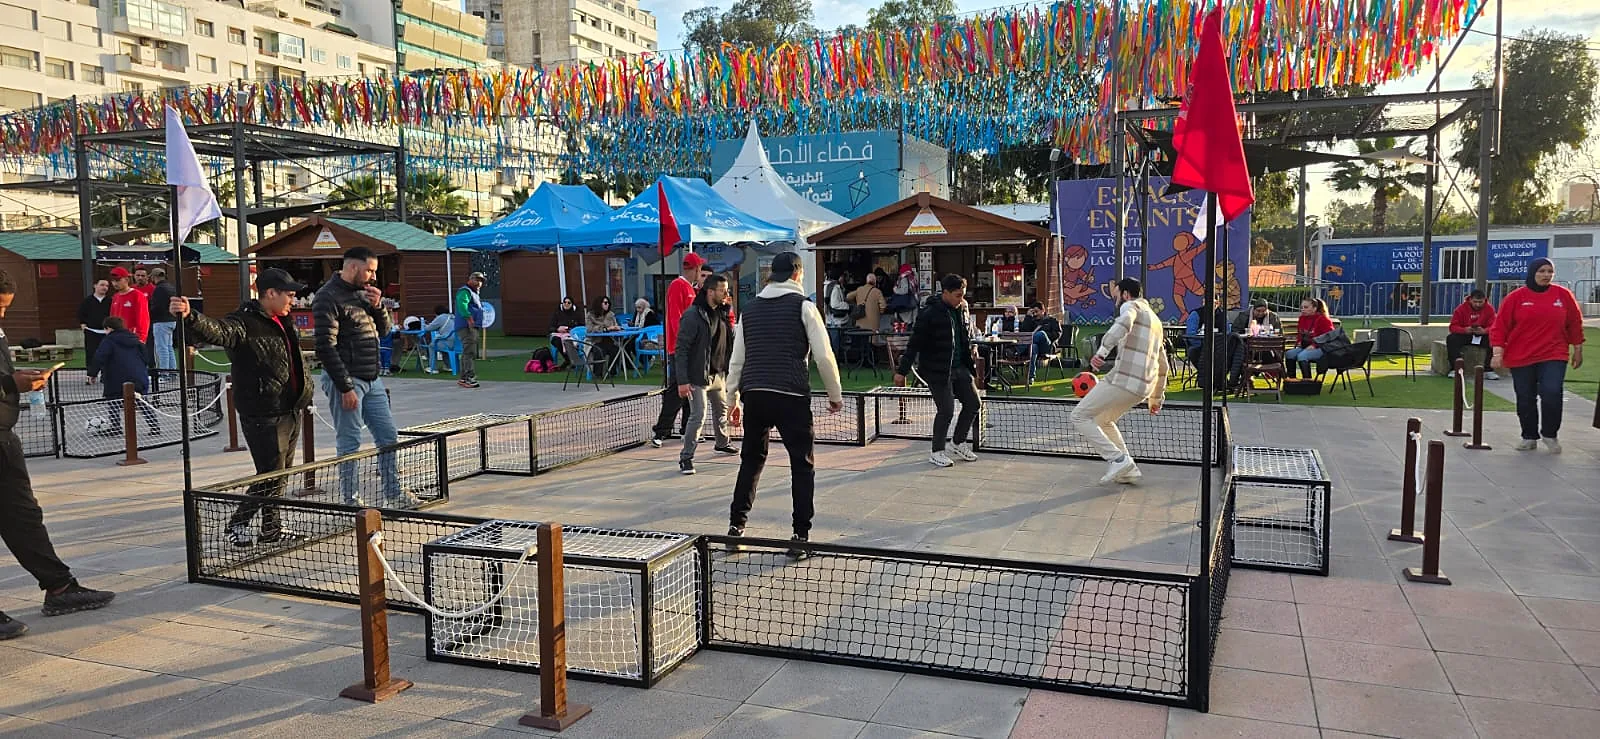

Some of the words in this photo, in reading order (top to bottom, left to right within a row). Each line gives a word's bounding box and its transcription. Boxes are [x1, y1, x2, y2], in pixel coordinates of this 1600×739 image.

[818, 140, 873, 162] فضاء
[1091, 238, 1105, 248] LA
[1107, 237, 1142, 248] RUT
[1090, 256, 1105, 266] LA
[1106, 255, 1142, 266] CUP
